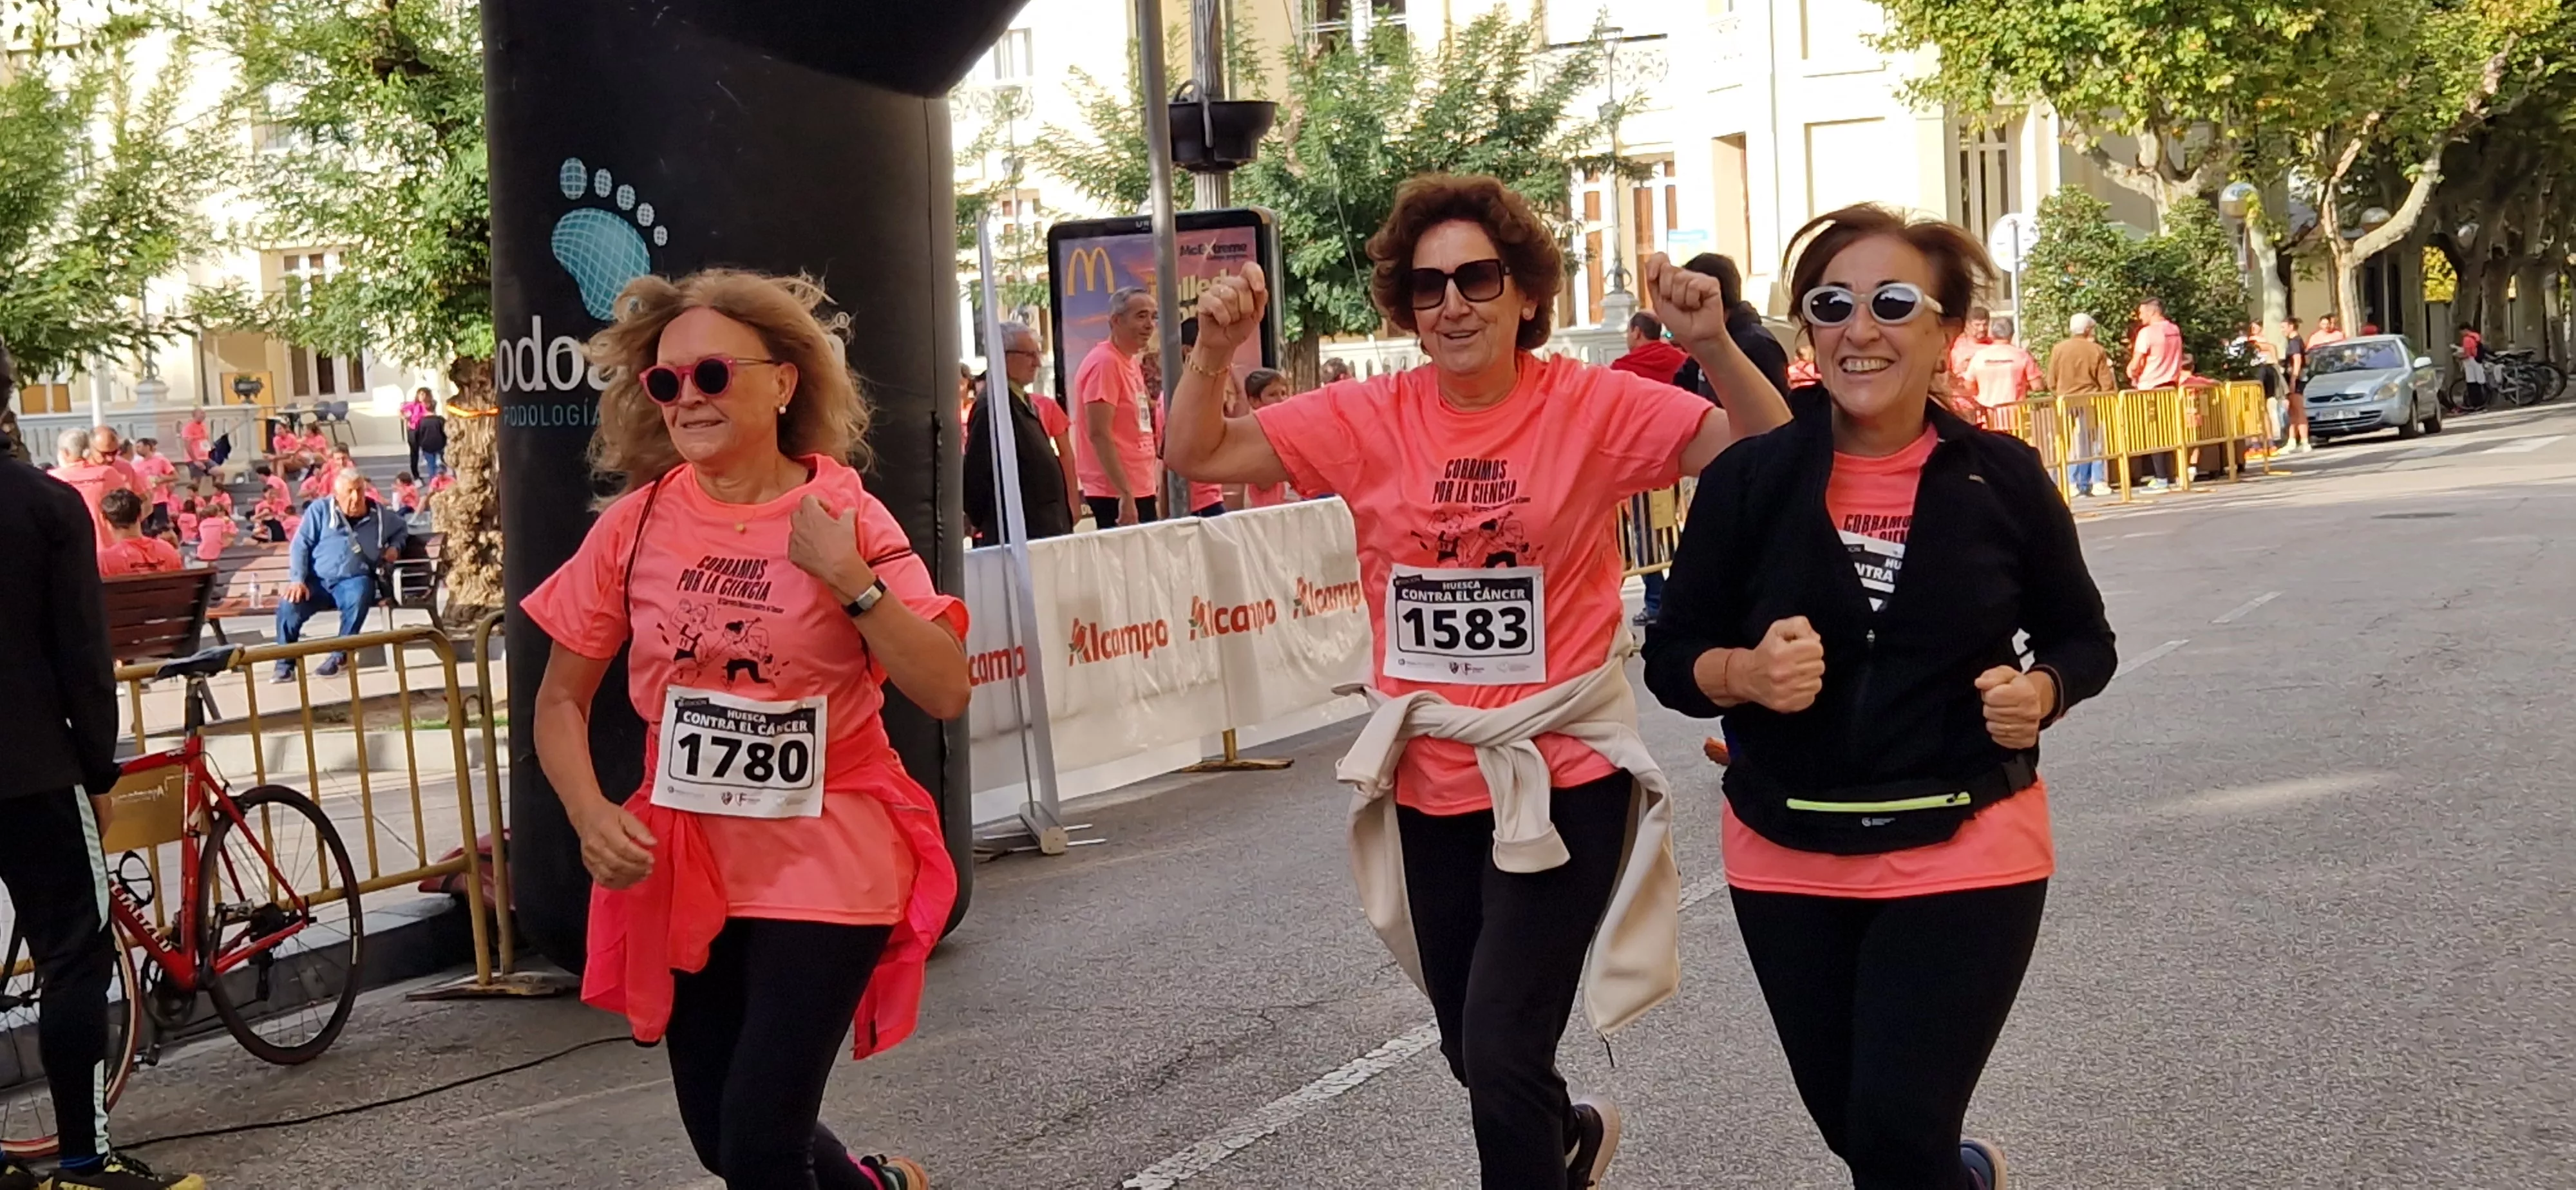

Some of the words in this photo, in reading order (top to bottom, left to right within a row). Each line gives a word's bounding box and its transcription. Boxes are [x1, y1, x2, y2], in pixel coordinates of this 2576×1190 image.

[1444, 458, 1508, 481] CORRAMOS
[1432, 480, 1454, 504] POR
[1455, 481, 1469, 503] LA
[1471, 480, 1517, 504] CIENCIA
[697, 555, 768, 580] CORRAMOS
[676, 569, 705, 592] POR
[702, 572, 721, 594] LA
[719, 578, 772, 602] CIENCIA
[1401, 589, 1454, 601] CONTRA
[1456, 590, 1472, 601] EL
[1473, 587, 1526, 601] CÁNCER
[1442, 581, 1481, 590] HUESCA
[1403, 607, 1528, 650] 1583
[1068, 618, 1169, 667] Alcampo
[683, 710, 736, 731] CONTRA
[739, 721, 754, 733] EL
[757, 720, 808, 735] CÁNCER
[727, 710, 766, 723] HUESCA
[678, 732, 809, 783] 1780
